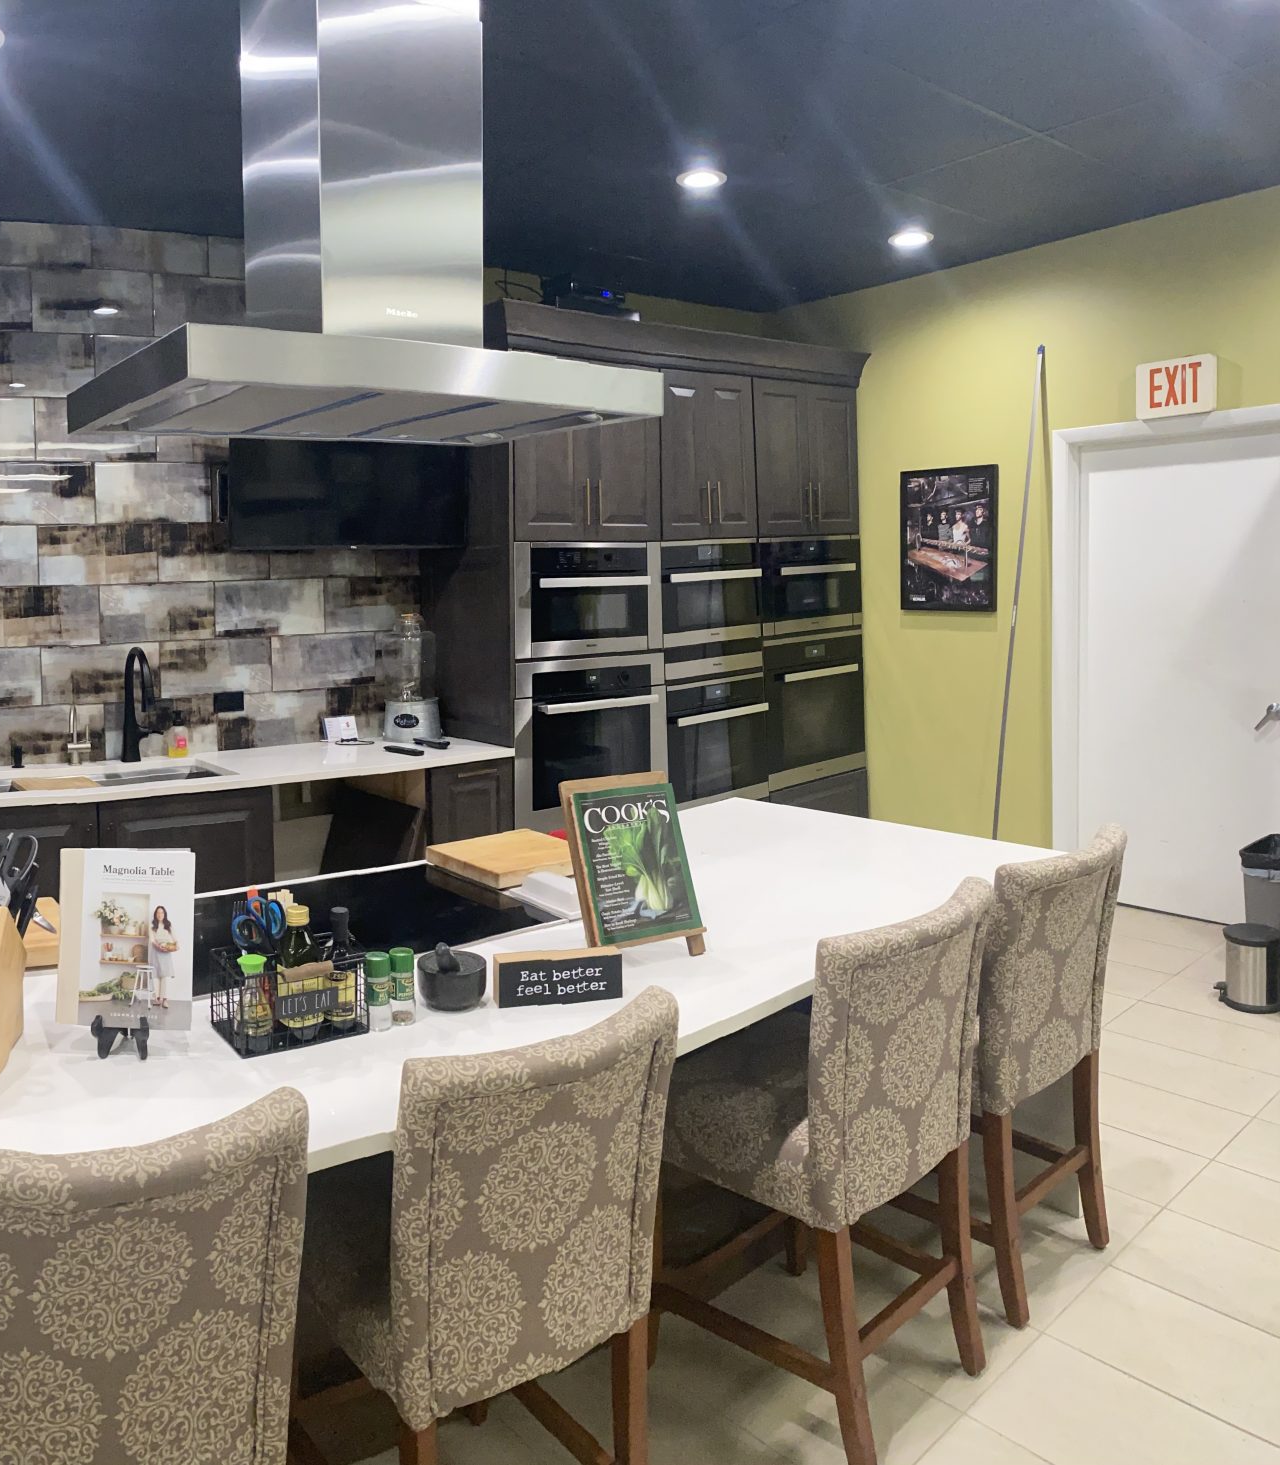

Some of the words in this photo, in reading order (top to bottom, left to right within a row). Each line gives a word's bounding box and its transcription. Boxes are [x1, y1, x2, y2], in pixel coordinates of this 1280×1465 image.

[1149, 361, 1202, 409] EXIT
[583, 799, 670, 834] COOK'S
[102, 864, 147, 876] Magnolia
[149, 866, 175, 876] Table
[520, 970, 548, 982] Eat
[552, 966, 603, 982] better
[516, 983, 552, 997] feel
[556, 980, 608, 995] better
[282, 995, 307, 1016] LET'S
[315, 990, 331, 1010] EAT
